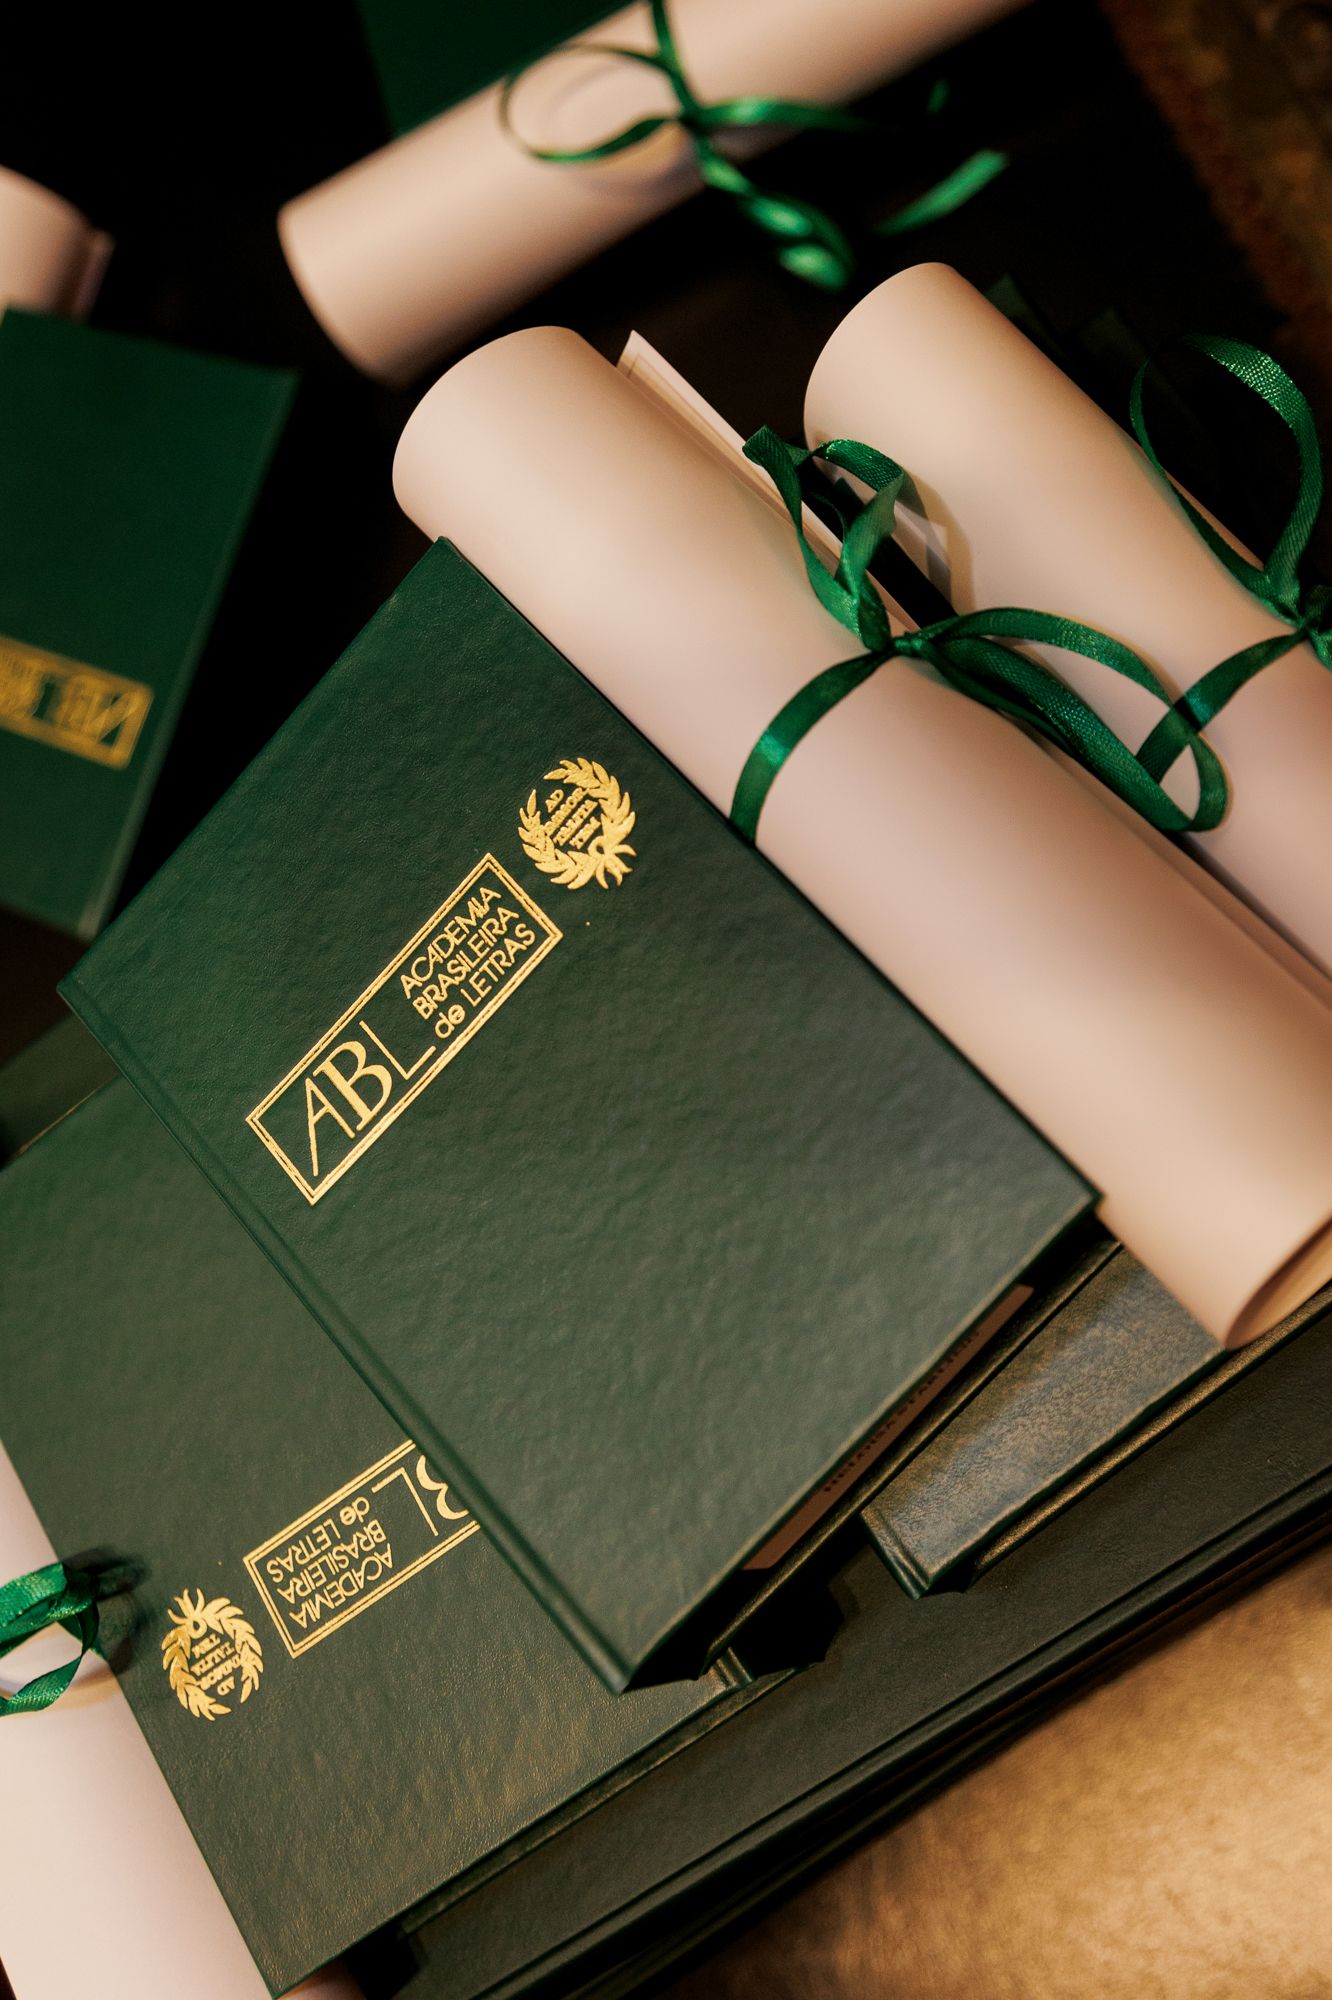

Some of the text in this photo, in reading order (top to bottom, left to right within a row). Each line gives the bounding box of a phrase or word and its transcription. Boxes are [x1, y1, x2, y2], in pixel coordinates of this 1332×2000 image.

[400, 887, 502, 999] ACADEMIA
[413, 907, 519, 1020] BRASILEIRA
[434, 923, 536, 1039] de LETRAS
[304, 1021, 436, 1177] ABL
[266, 1496, 370, 1583] de LETRAS
[371, 1455, 470, 1537] BL
[277, 1519, 387, 1604] BRASILEIRA
[289, 1544, 393, 1629] ACADEMIA
